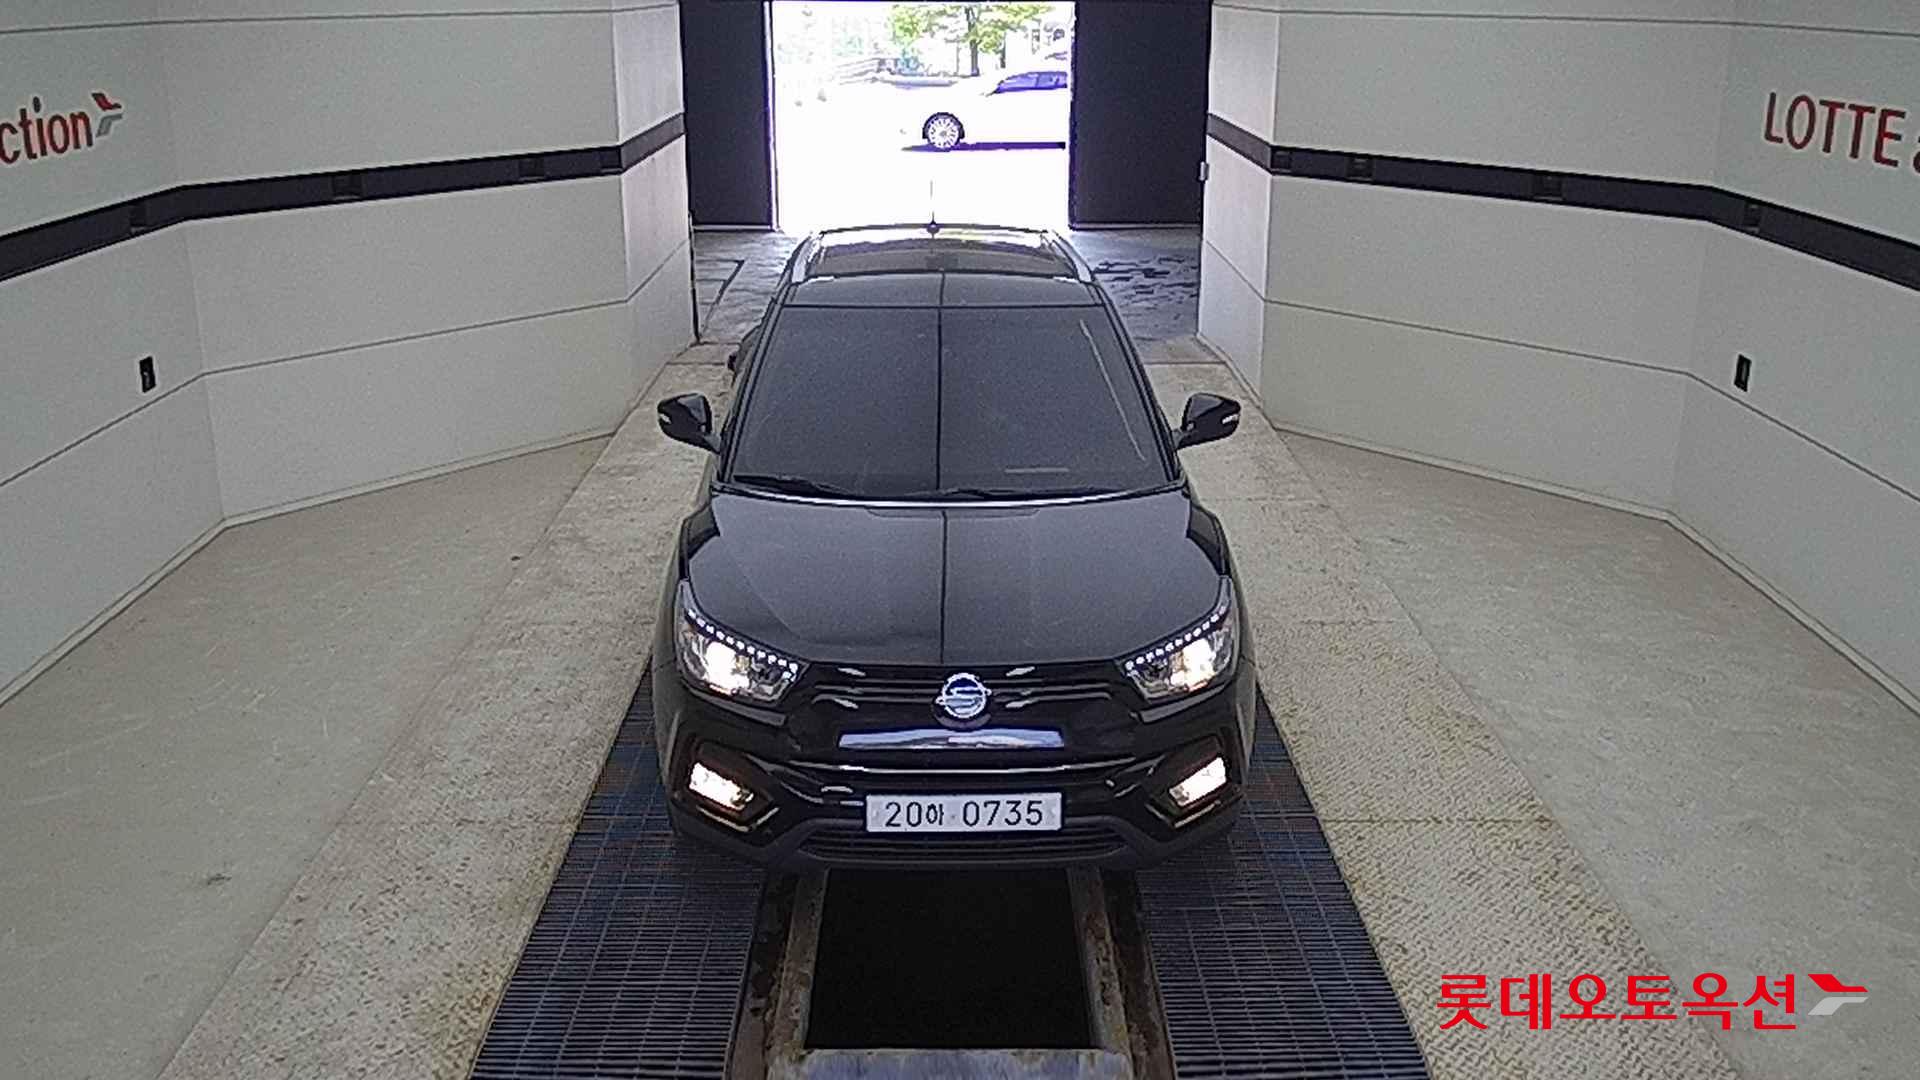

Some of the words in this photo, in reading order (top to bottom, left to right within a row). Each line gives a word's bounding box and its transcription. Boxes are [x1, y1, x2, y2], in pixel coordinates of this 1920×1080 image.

[0, 97, 93, 164] ction
[1764, 92, 1907, 167] LOTTE
[963, 800, 1043, 827] 0735
